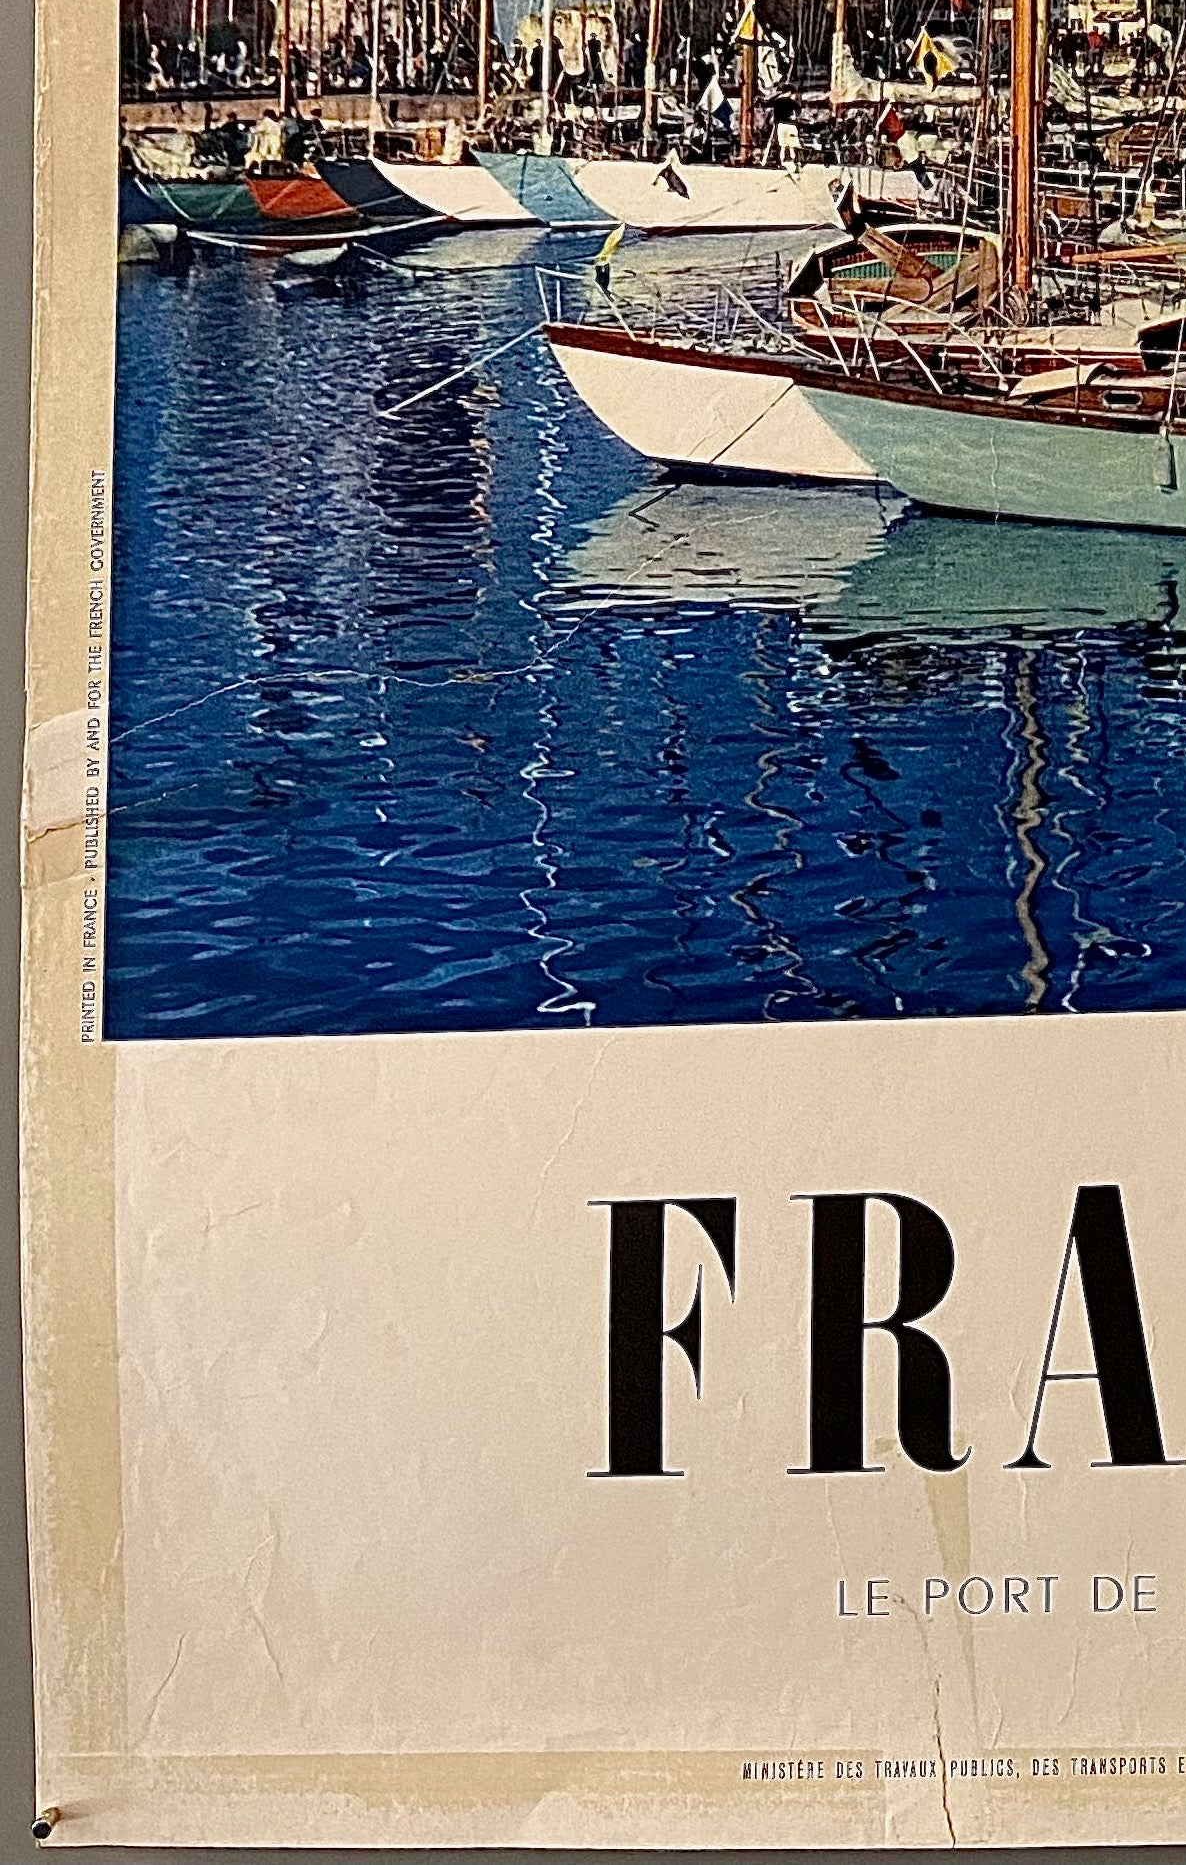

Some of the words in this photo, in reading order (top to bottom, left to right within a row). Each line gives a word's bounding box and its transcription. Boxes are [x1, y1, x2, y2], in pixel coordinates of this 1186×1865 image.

[90, 470, 106, 571] GOVERNMENT
[89, 580, 104, 638] FRENCH
[88, 646, 102, 673] THE
[88, 681, 102, 709] FOR
[87, 718, 101, 750] AND
[86, 758, 100, 777] BY
[84, 786, 100, 869] PUBLISHED
[83, 889, 98, 947] FRANCE
[82, 957, 96, 972] IN
[81, 981, 96, 1043] PRINTED
[838, 1579, 890, 1616] LE
[925, 1576, 1059, 1615] PORT
[1093, 1575, 1157, 1612] DE
[836, 1761, 863, 1779] DES
[874, 1760, 937, 1779] TRAVAUX
[950, 1758, 1020, 1779] PUBLICS,
[1032, 1758, 1059, 1777] DES
[1071, 1757, 1166, 1776] TRANSPORTS
